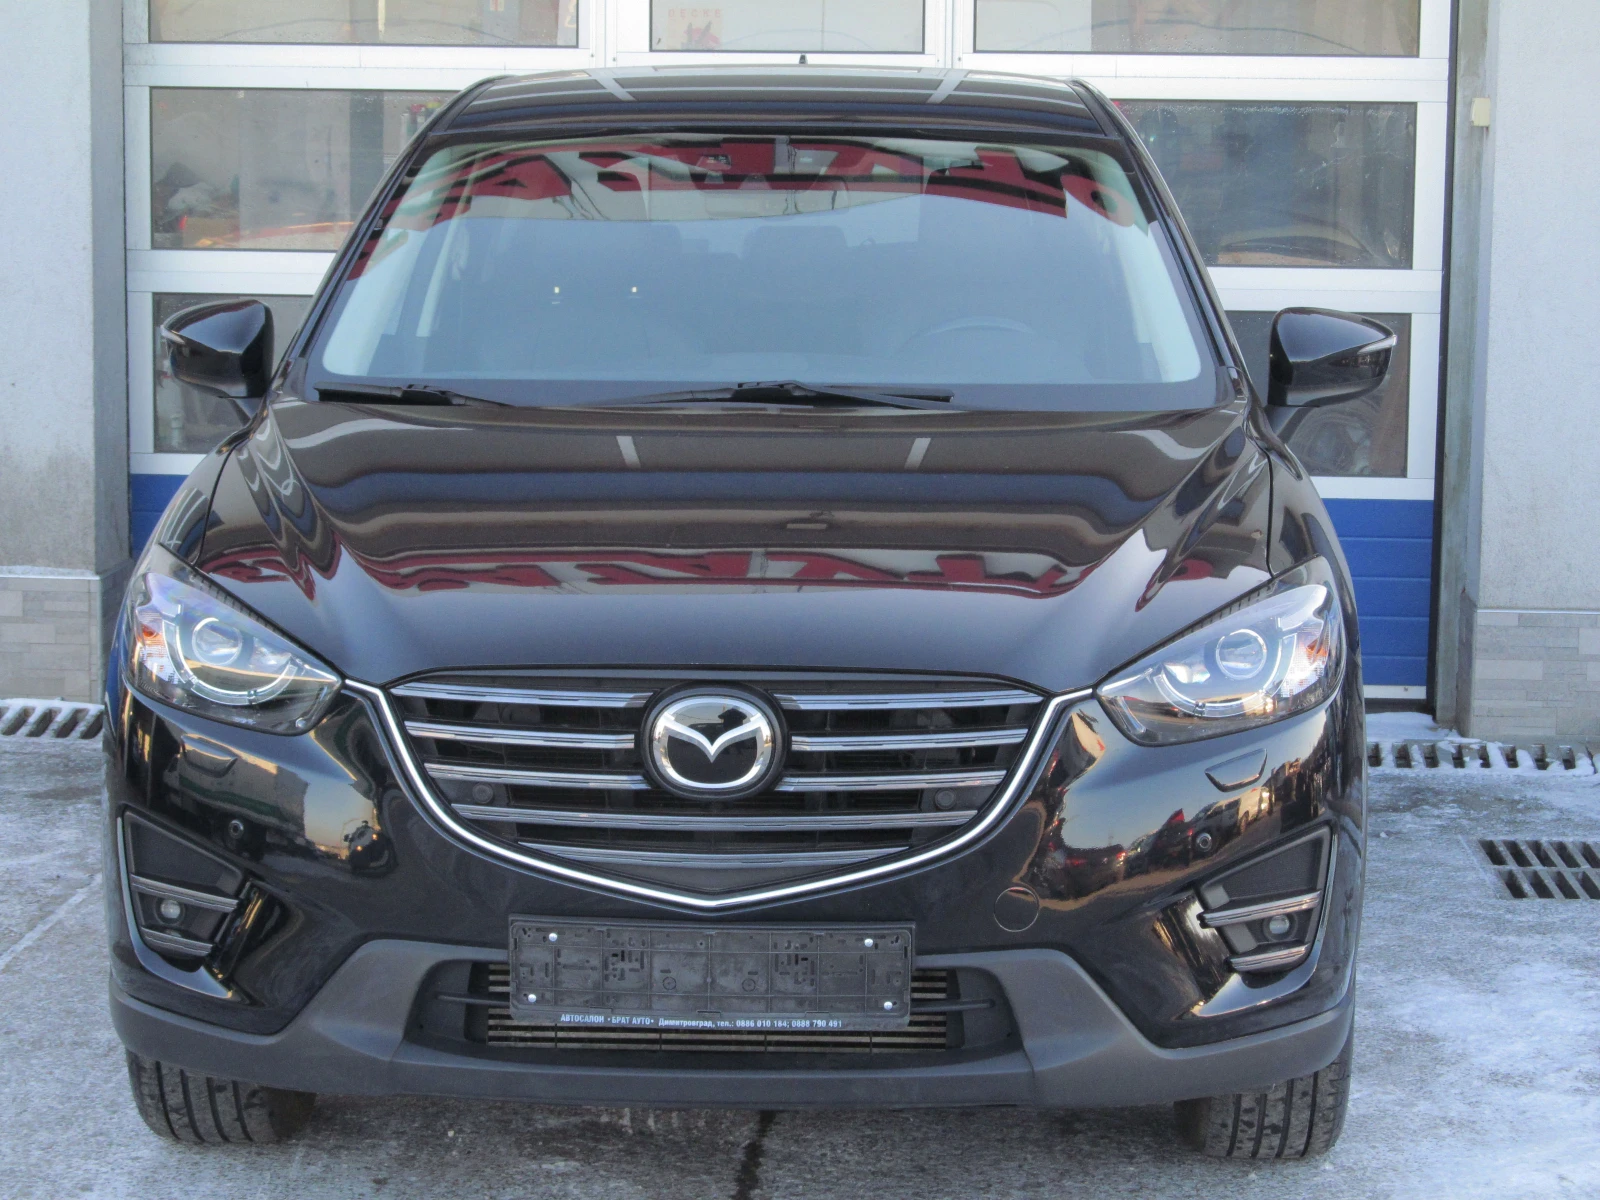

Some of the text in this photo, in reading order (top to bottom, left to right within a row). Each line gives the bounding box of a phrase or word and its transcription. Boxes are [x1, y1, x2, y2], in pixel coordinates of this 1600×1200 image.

[560, 1013, 605, 1023] АВТОСАЛОН
[736, 1019, 755, 1028] 0886
[756, 1019, 771, 1028] 010
[812, 1020, 826, 1028] 790
[828, 1020, 842, 1028] 491
